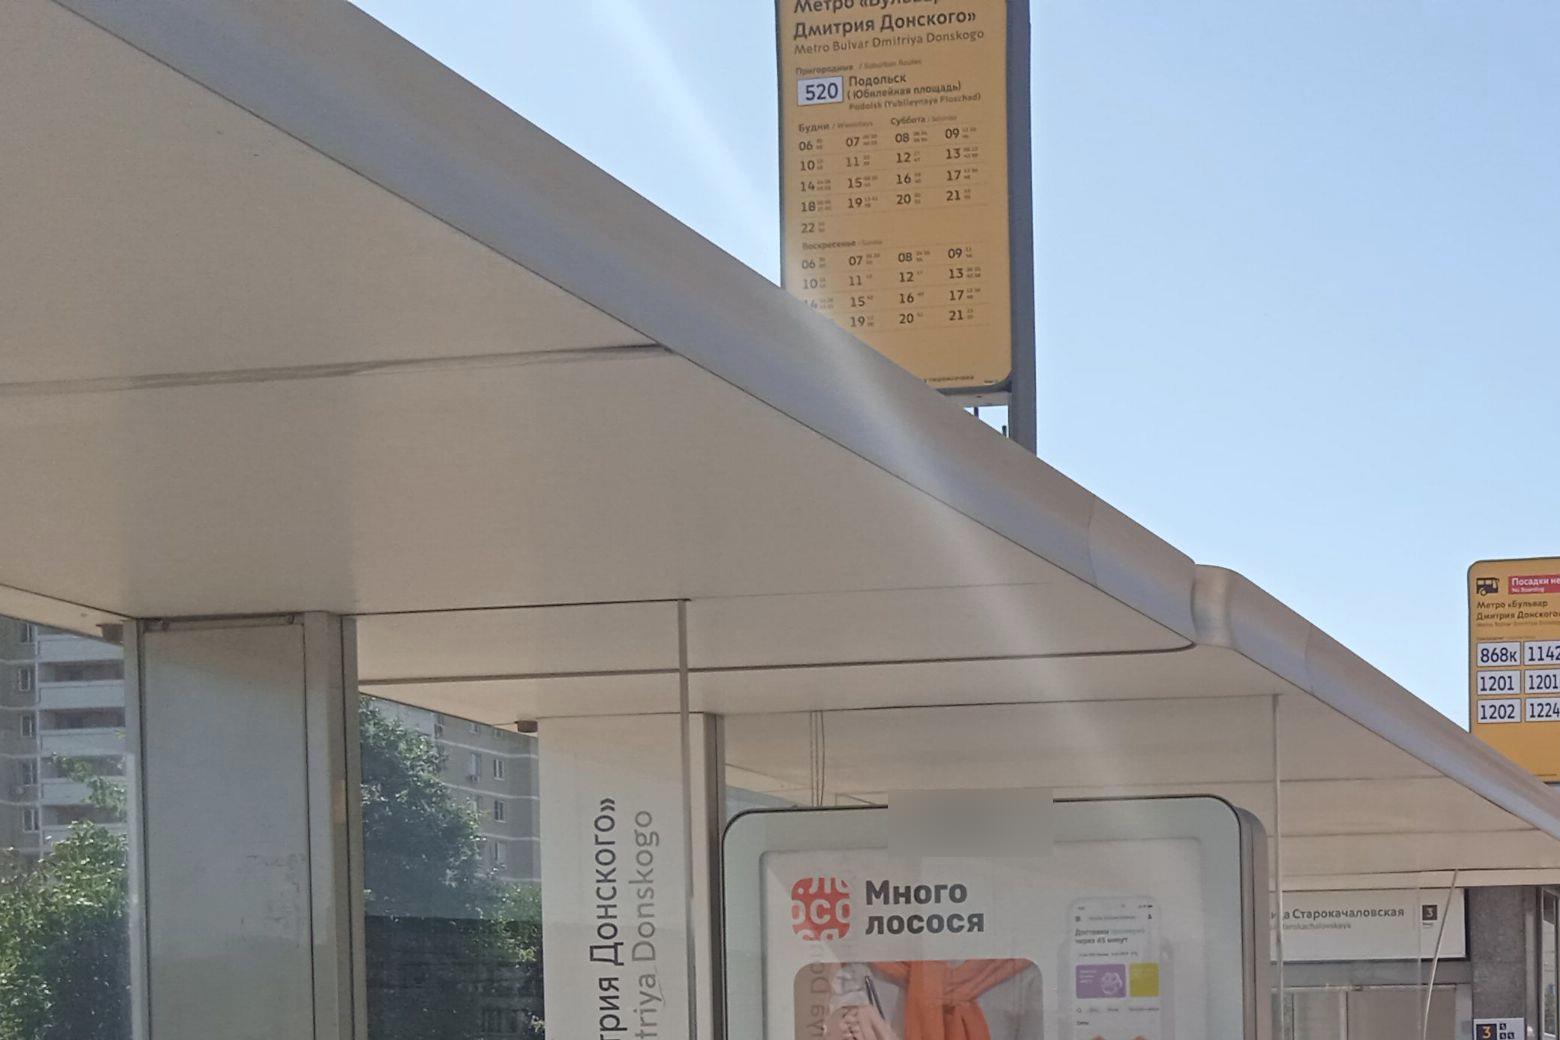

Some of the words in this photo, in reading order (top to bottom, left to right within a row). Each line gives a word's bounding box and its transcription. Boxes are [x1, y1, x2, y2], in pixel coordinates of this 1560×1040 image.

[793, 19, 875, 40] Дмитрия
[880, 11, 977, 32] Донского»
[794, 43, 830, 55] Metro
[833, 39, 869, 52] Bulvar
[873, 34, 923, 49] Dmitriya
[927, 29, 985, 43] Donskogo
[805, 82, 839, 101] 520
[849, 74, 907, 87] Подольск
[798, 122, 830, 134] Будни
[799, 140, 814, 151] 06
[846, 136, 860, 148] 07
[895, 132, 910, 144] 08
[945, 128, 960, 139] 09
[800, 160, 815, 171] 10
[846, 156, 860, 168] 11
[896, 152, 911, 163] 12
[946, 148, 960, 159] 13
[800, 181, 815, 192] 14
[848, 178, 862, 188] 15
[896, 173, 911, 184] 16
[947, 170, 962, 180] 17
[801, 201, 816, 212] 18
[848, 198, 862, 208] 19
[896, 194, 911, 205] 20
[947, 190, 962, 201] 21
[801, 223, 816, 234] 22
[848, 256, 863, 267] 07
[898, 252, 912, 263] 08
[948, 248, 962, 260] 09
[850, 276, 864, 286] 11
[900, 272, 914, 283] 12
[949, 268, 964, 279] 13
[850, 296, 865, 307] 15
[899, 293, 914, 304] 16
[949, 290, 964, 300] 17
[850, 316, 865, 328] 19
[900, 314, 914, 324] 20
[949, 310, 964, 322] 21
[1512, 577, 1549, 587] Посадки
[1476, 601, 1505, 610] Метро
[1480, 647, 1517, 663] 868к
[1480, 675, 1514, 691] 1201
[1480, 704, 1515, 720] 1202
[590, 798, 625, 967] Донского»
[630, 810, 660, 962] Donskogo
[865, 880, 968, 905] Много
[1292, 908, 1405, 921] Старокачаловская
[865, 913, 985, 936] лосося
[1482, 1026, 1492, 1039] 3
